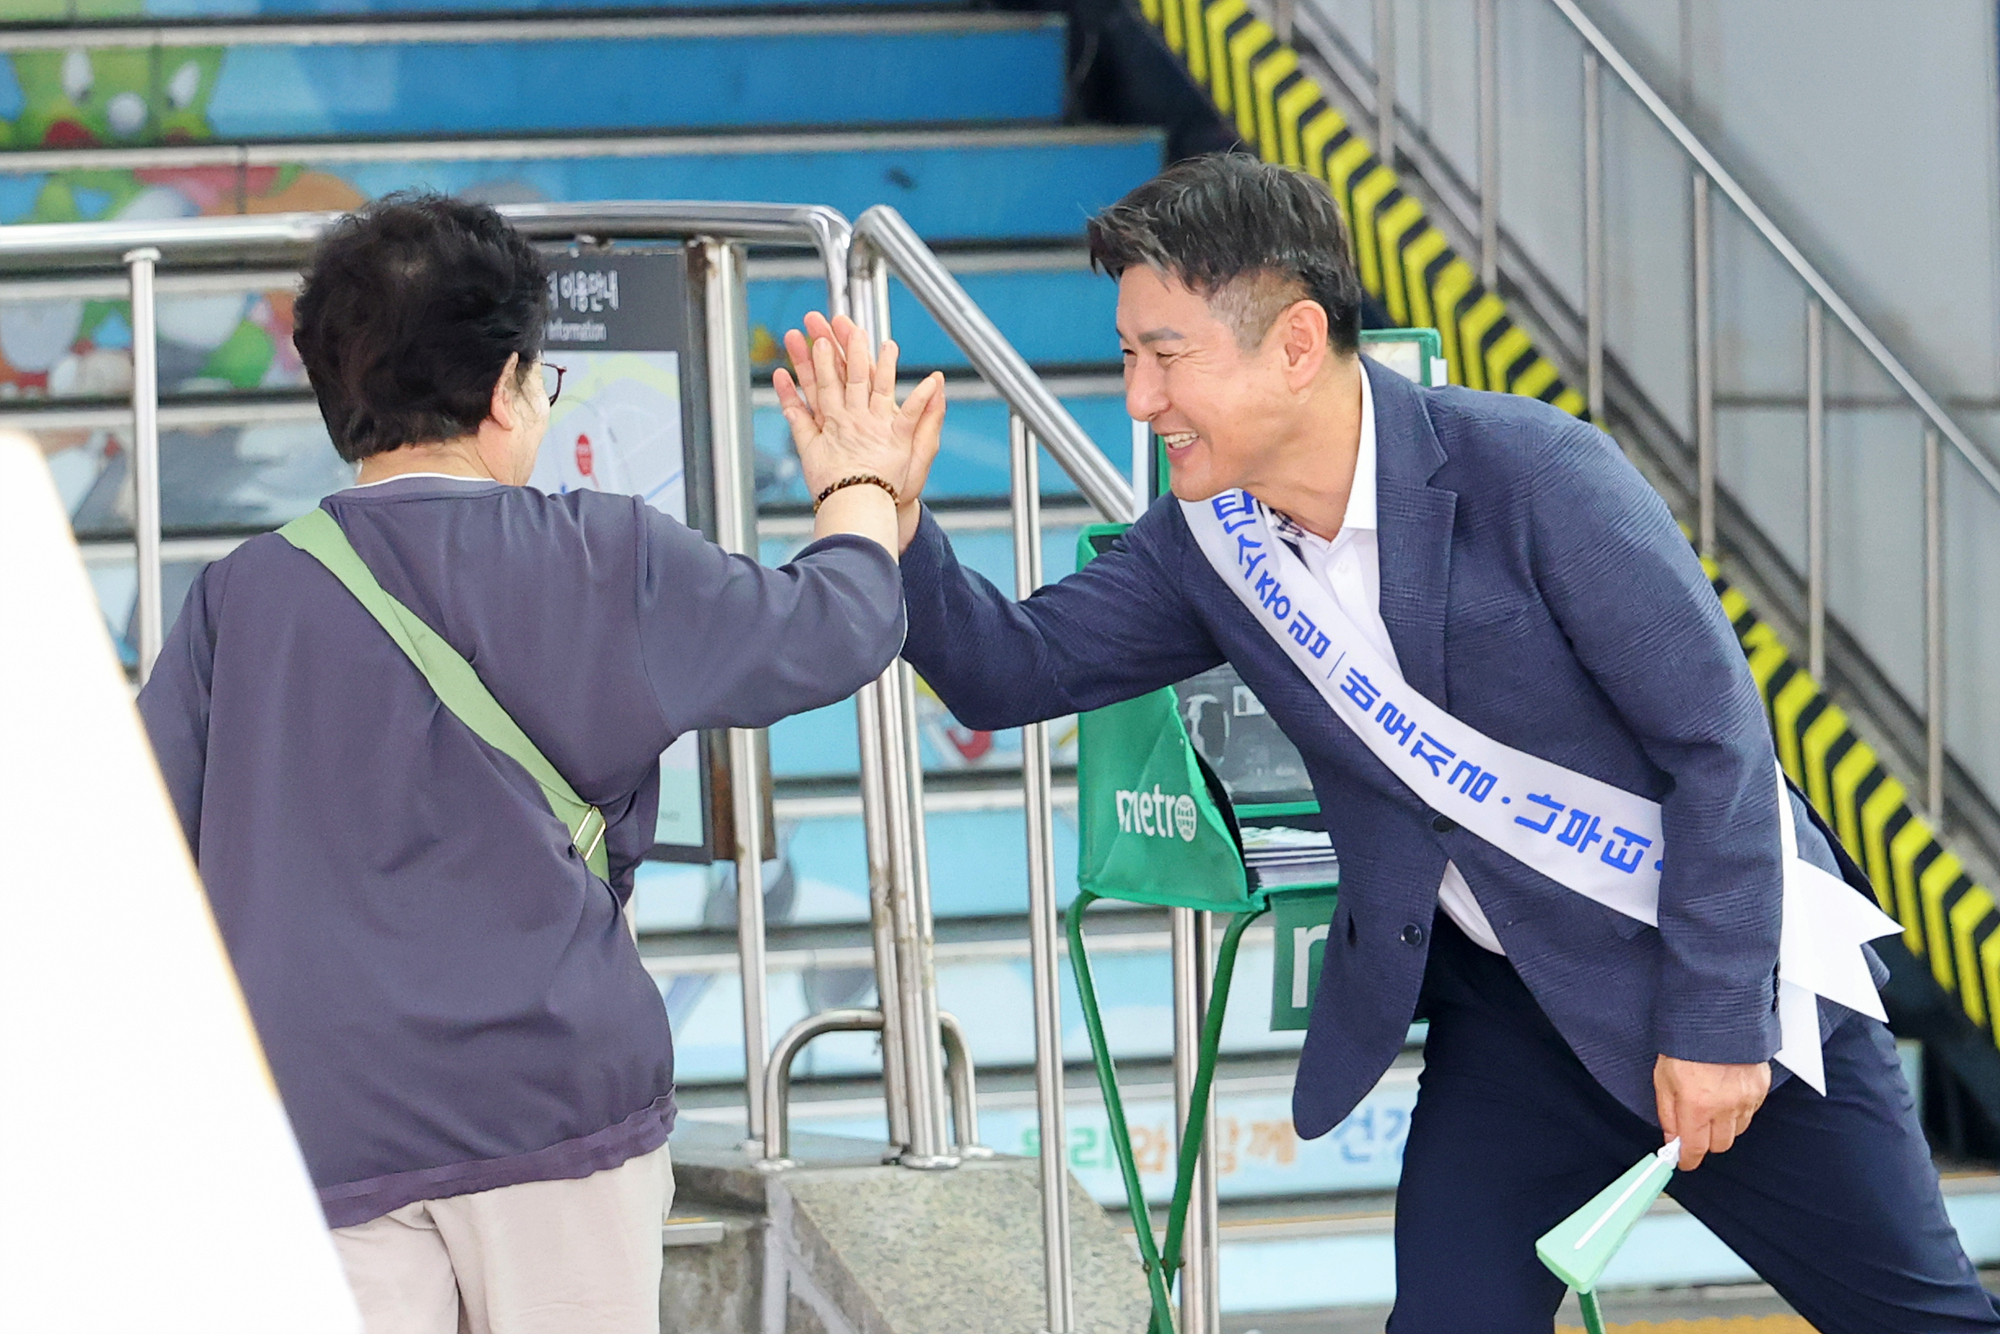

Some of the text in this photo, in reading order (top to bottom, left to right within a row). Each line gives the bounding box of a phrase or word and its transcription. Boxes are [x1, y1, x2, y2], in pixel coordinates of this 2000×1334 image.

[561, 270, 619, 312] 이용안내
[1211, 489, 1653, 874] 탄소중립 바로지금 나부터
